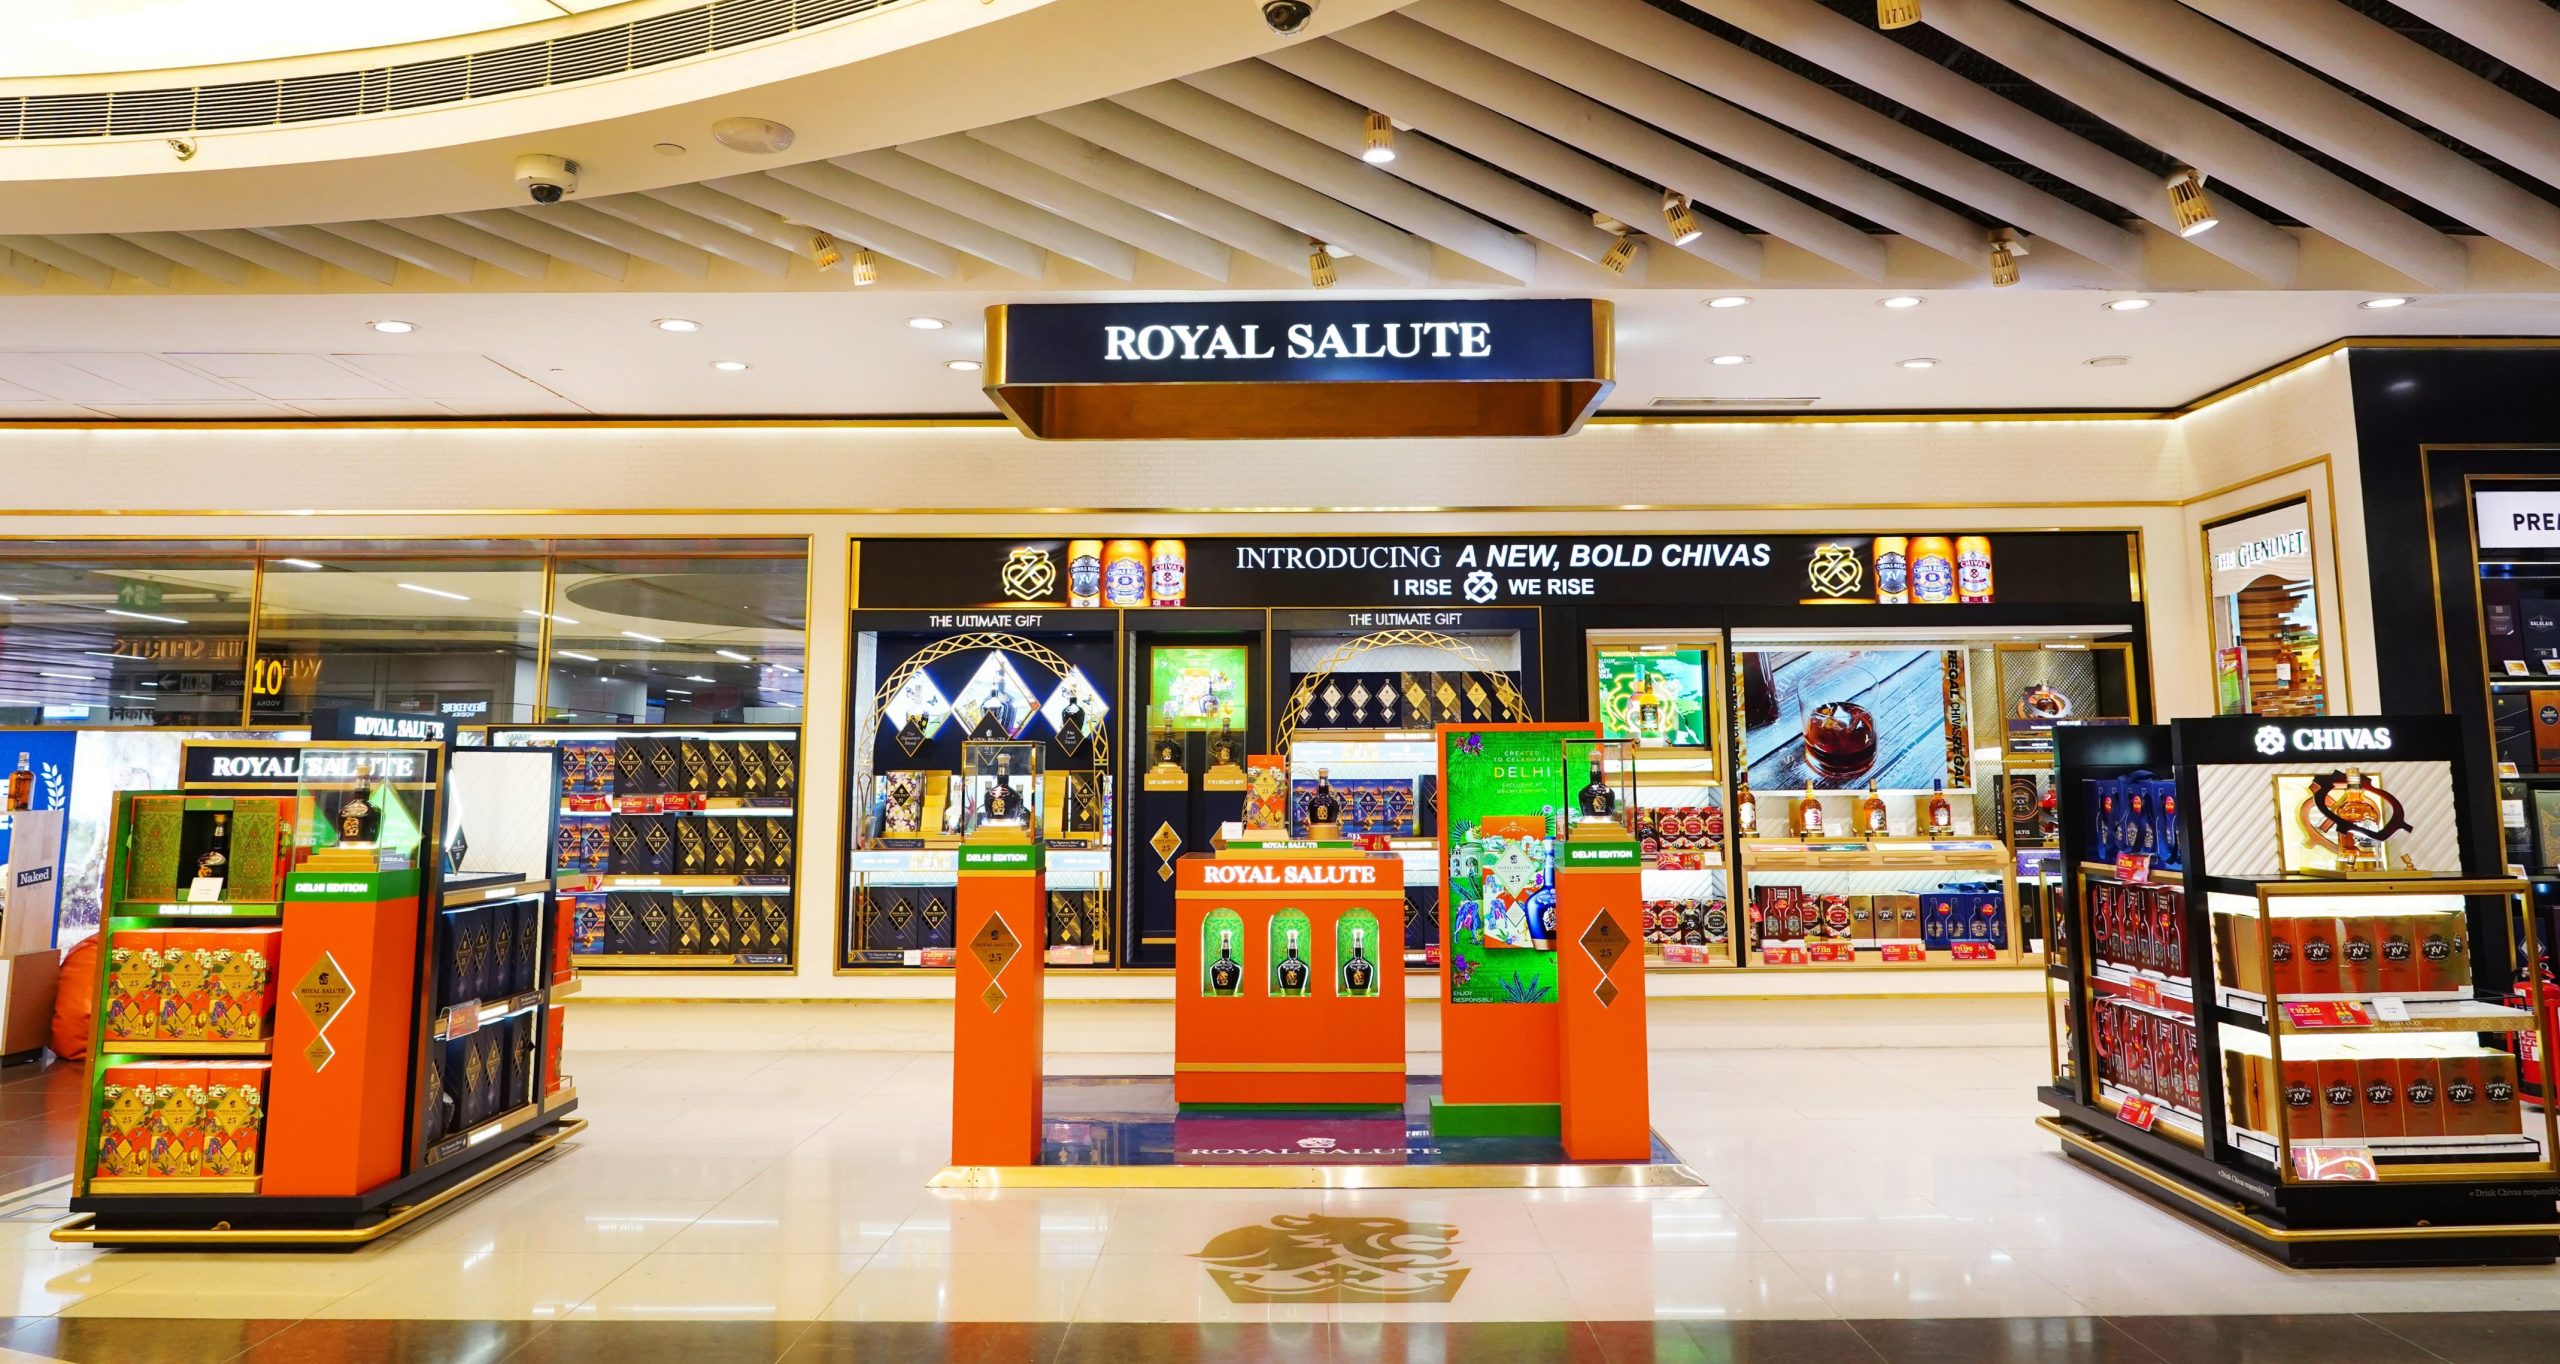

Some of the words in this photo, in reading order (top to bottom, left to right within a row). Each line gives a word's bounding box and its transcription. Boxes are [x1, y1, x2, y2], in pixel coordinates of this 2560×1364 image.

[1103, 325, 1274, 361] ROYAL
[1287, 323, 1492, 358] SALUTE
[2215, 555, 2235, 569] THE
[2238, 531, 2304, 567] GLENLIVET
[1236, 546, 1442, 568] INTRODUCING
[1456, 545, 1477, 567] A
[1486, 545, 1558, 571] NEW,
[1569, 544, 1652, 567] BOLD
[1661, 544, 1771, 567] CHIVAS
[1154, 564, 1181, 572] CHIVAS
[1960, 560, 1986, 568] CHIVAS
[1079, 574, 1093, 585] XV
[1886, 571, 1900, 582] XV
[1393, 579, 1399, 595] I
[1405, 579, 1452, 595] RISE
[1508, 579, 1541, 594] WE
[1548, 579, 1594, 594] RISE
[930, 614, 952, 628] THE
[956, 614, 1012, 628] ULTIMATE
[1015, 614, 1042, 627] GIFT
[1349, 614, 1372, 626] THE
[1376, 613, 1432, 626] ULTIMATE
[1434, 613, 1462, 625] GIFT
[253, 659, 283, 695] 10
[1950, 701, 1961, 736] CHIVAS
[354, 716, 398, 737] ROYAL
[398, 719, 444, 740] SALUTE
[2293, 728, 2392, 750] CHIVAS
[984, 747, 994, 755] 21
[1952, 736, 1964, 786] REGAL
[212, 757, 301, 777] ROYAL
[305, 757, 413, 777] SALUTE
[1494, 766, 1551, 778] DELHI
[966, 854, 990, 862] DELHI
[993, 854, 1028, 862] EDITION
[1572, 850, 1597, 859] DELHI
[1598, 850, 1632, 859] EDITION
[20, 869, 50, 884] Naked
[1204, 866, 1280, 884] ROYAL
[1284, 866, 1376, 884] SALUTE
[295, 883, 324, 892] DELHI
[326, 883, 368, 892] EDITION
[1600, 949, 1612, 957] 25
[2312, 948, 2324, 958] XV
[2352, 947, 2364, 957] XV
[2391, 946, 2402, 956] XV
[2430, 946, 2442, 955] XV
[988, 952, 1002, 963] 25
[315, 1002, 330, 1014] 25
[2294, 1092, 2306, 1101] XV
[2334, 1090, 2346, 1100] XV
[2374, 1090, 2386, 1100] XV
[2416, 1090, 2428, 1099] XV
[2455, 1088, 2468, 1098] XV
[2493, 1088, 2506, 1097] XV
[2221, 1170, 2232, 1181] Drink
[2232, 1174, 2244, 1186] Chivas
[2245, 1182, 2266, 1198] responsibly
[2476, 1188, 2496, 1197] Drink
[2497, 1188, 2522, 1196] Chivas
